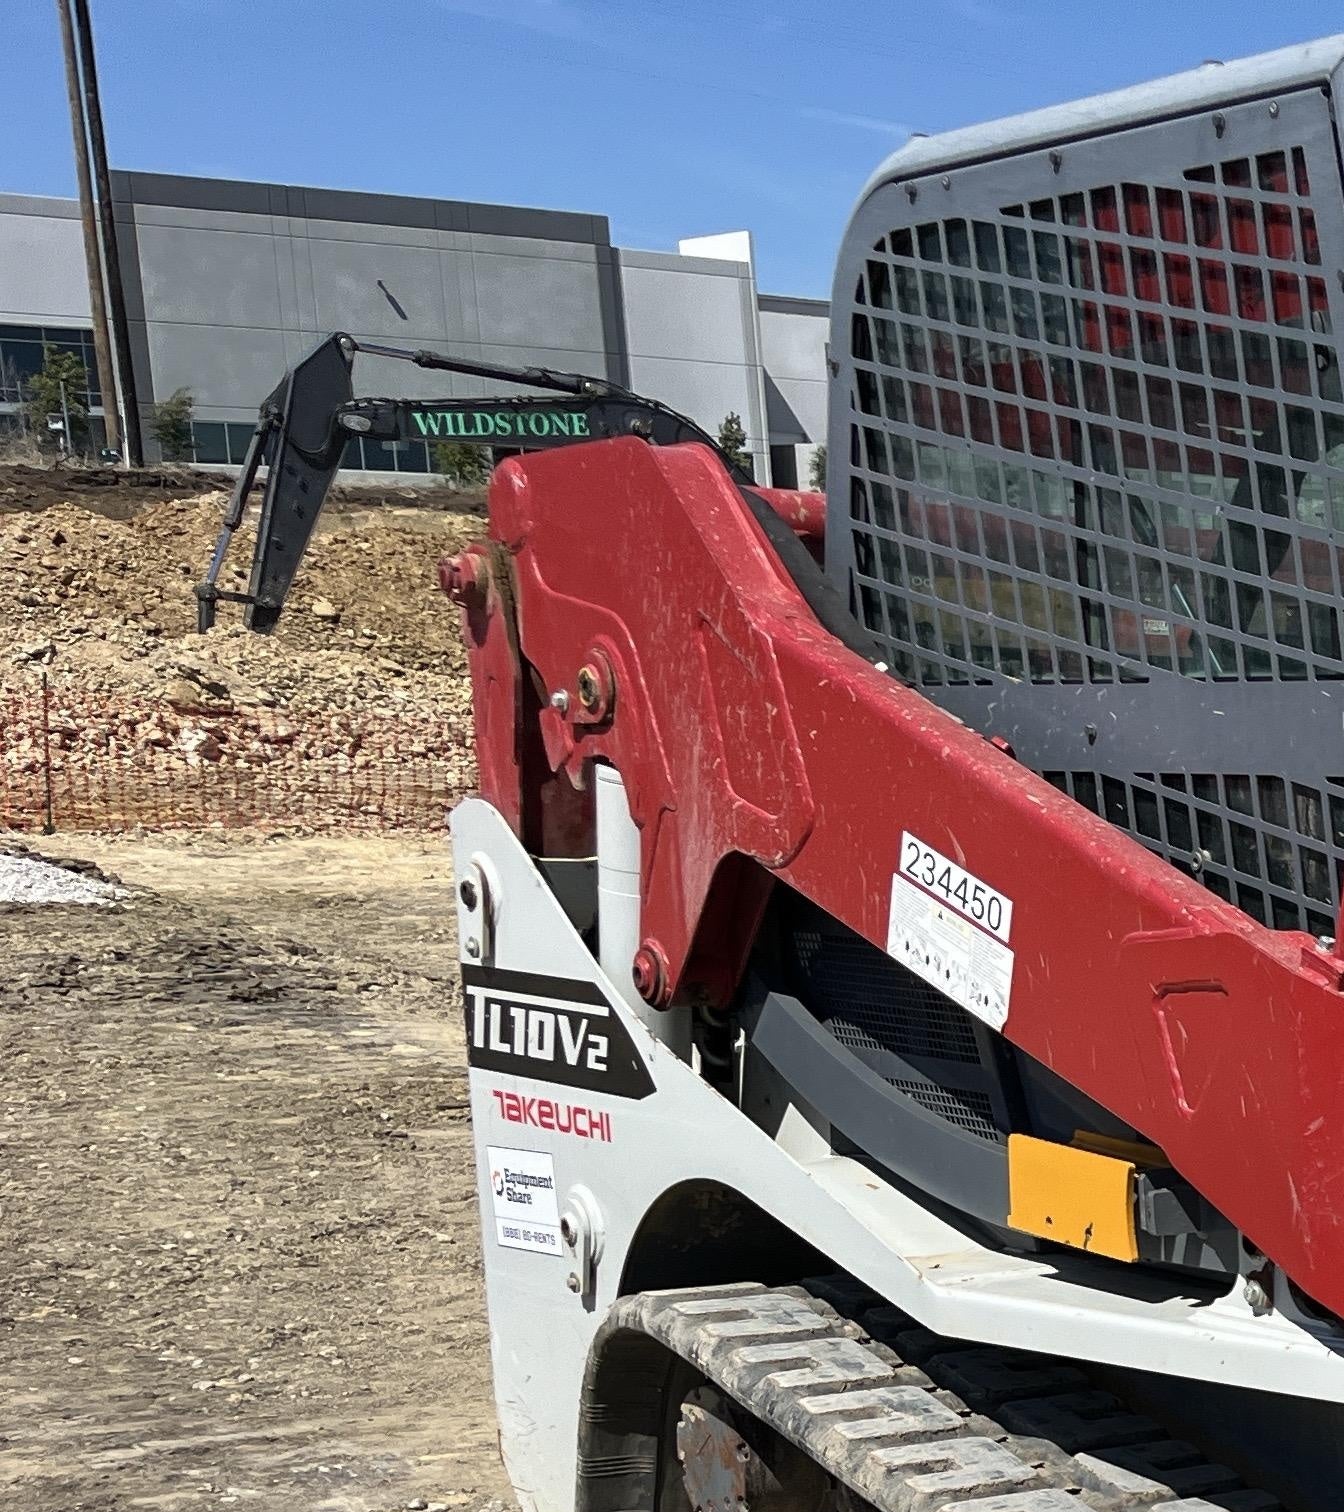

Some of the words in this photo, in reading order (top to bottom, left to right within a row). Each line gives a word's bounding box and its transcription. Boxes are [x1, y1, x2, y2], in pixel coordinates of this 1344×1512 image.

[411, 412, 591, 437] WILDSTONE
[905, 841, 1003, 931] 234450
[466, 984, 610, 1072] TL10V2
[503, 1167, 554, 1190] Equipment
[506, 1187, 533, 1205] Share
